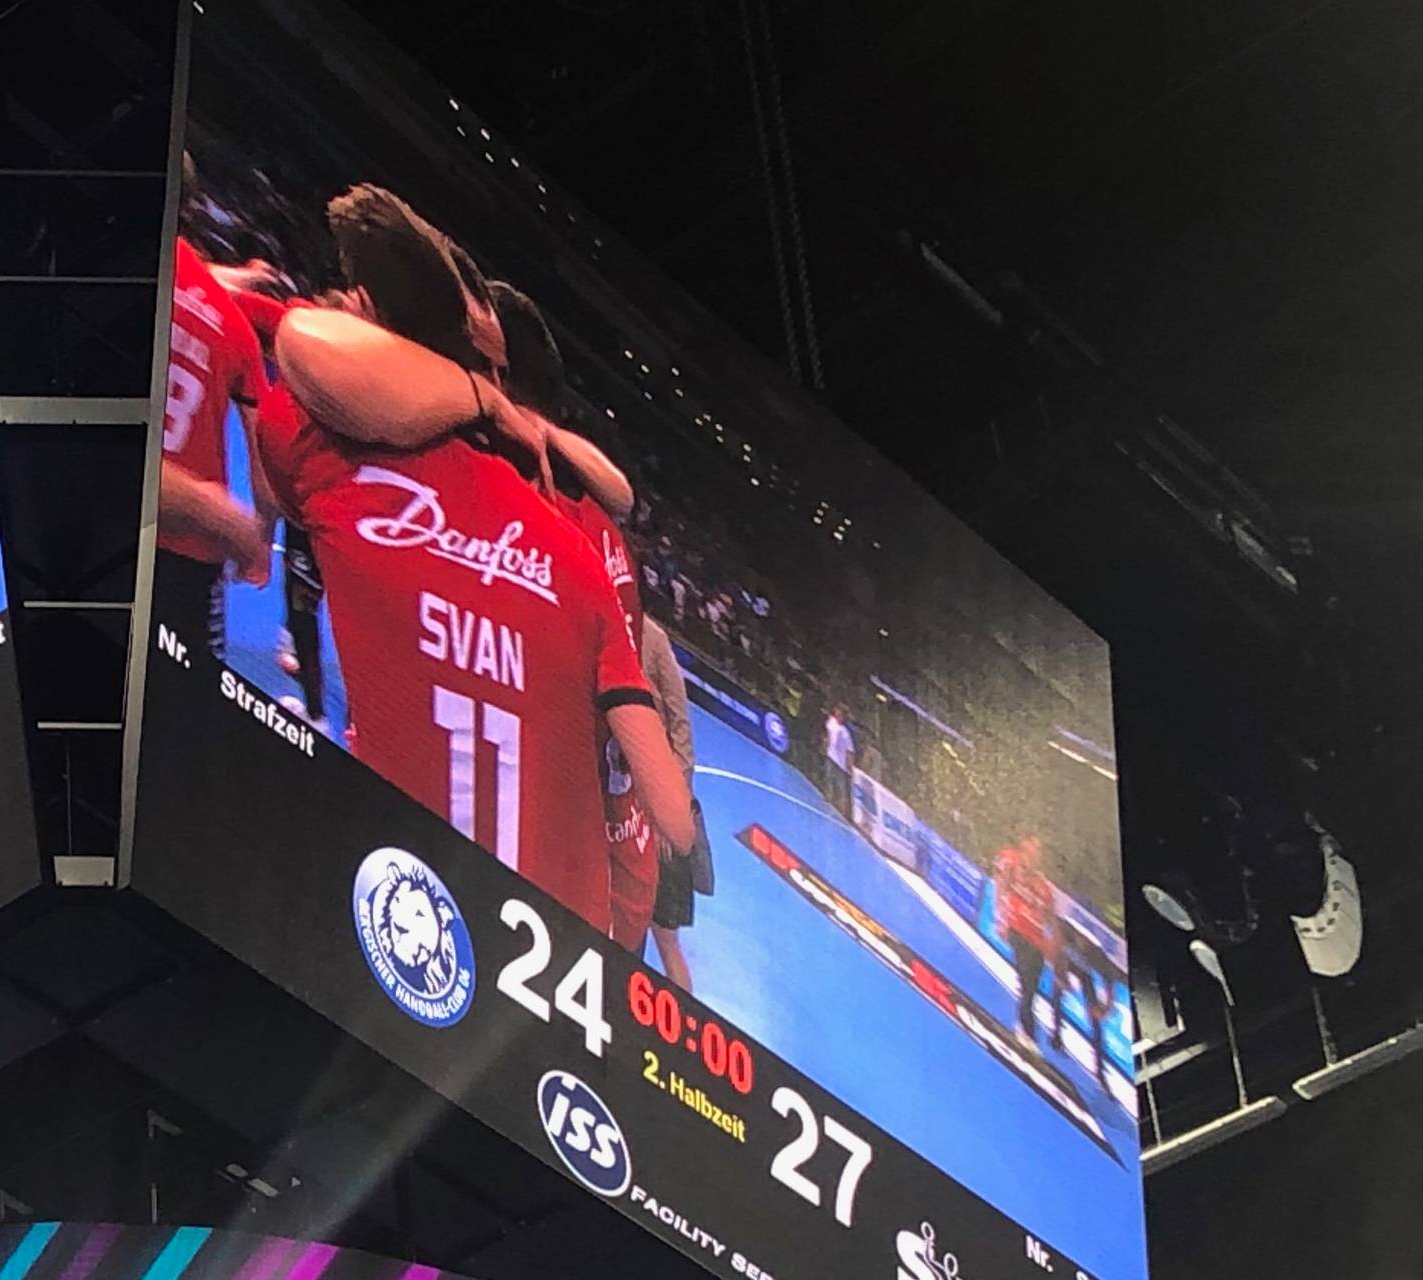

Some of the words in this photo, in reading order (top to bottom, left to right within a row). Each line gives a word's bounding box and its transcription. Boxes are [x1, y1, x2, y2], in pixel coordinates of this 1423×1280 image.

[352, 464, 560, 607] Danfoss
[157, 622, 192, 669] Nr.
[219, 669, 316, 758] Strafzeit
[419, 590, 525, 693] SVAN
[433, 684, 521, 873] 11
[496, 898, 612, 1059] 24
[627, 970, 754, 1095] 60:00
[642, 1050, 667, 1090] 2.
[669, 1076, 747, 1143] Halbzeit
[770, 1086, 873, 1228] 27
[630, 1184, 727, 1258] FACILITY
[1025, 1234, 1054, 1273] Nr.
